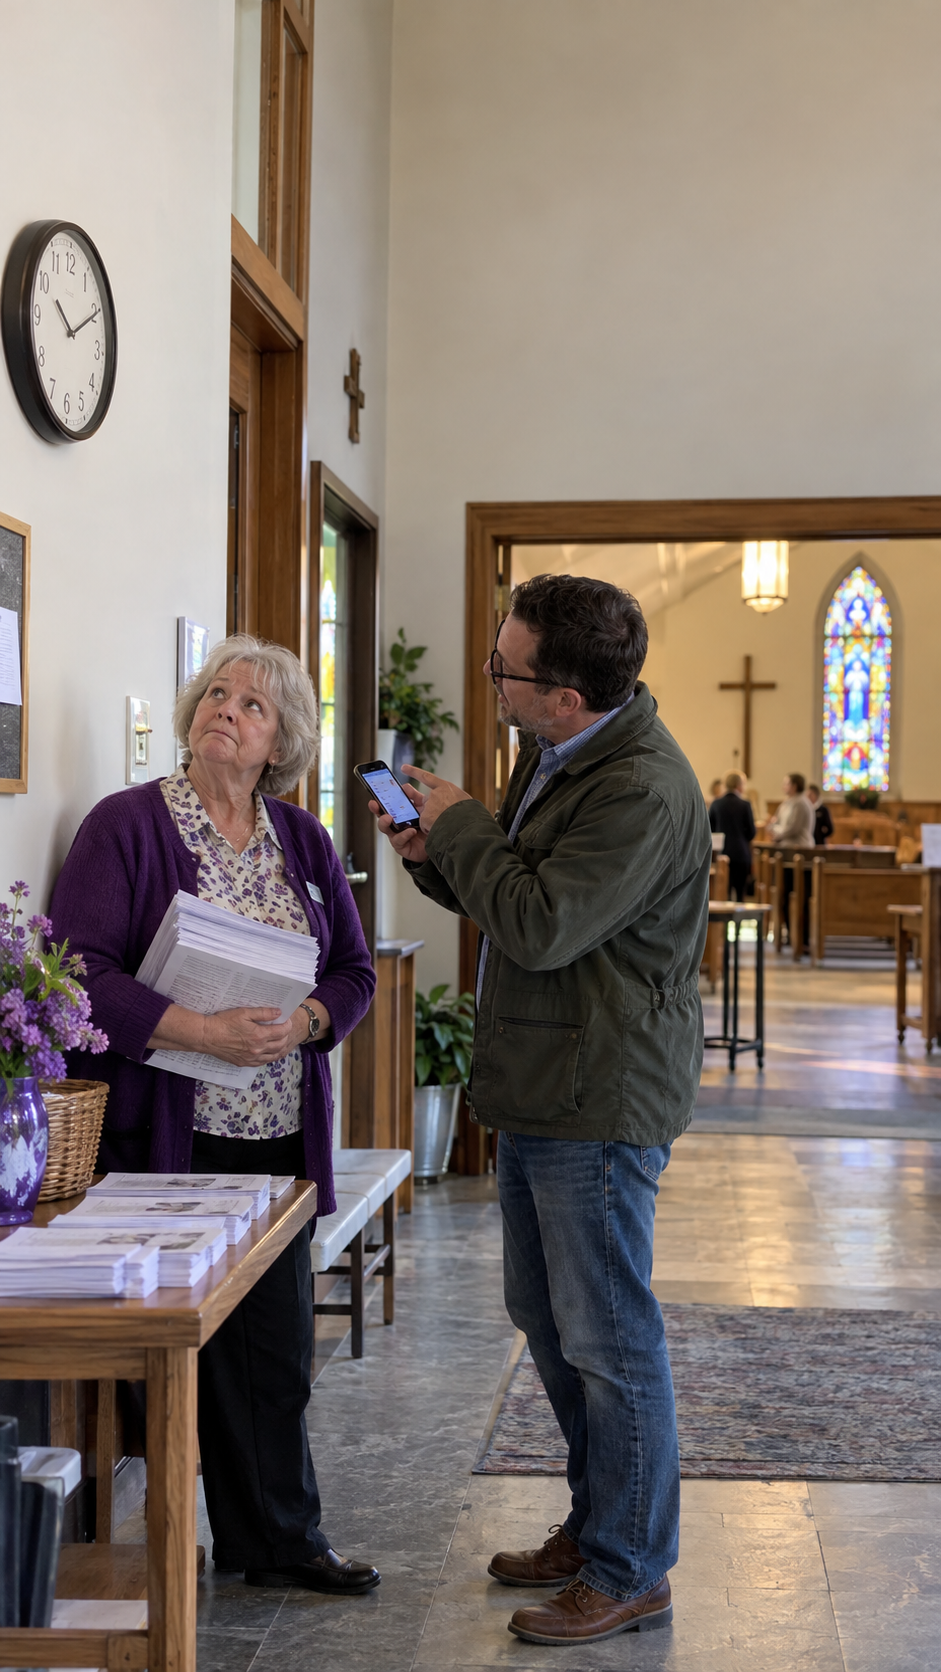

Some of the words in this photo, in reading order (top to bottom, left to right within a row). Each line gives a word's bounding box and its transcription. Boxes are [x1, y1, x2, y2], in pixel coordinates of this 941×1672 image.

[52, 251, 60, 274] 11
[66, 251, 76, 276] 12
[39, 270, 50, 294] 10
[83, 272, 87, 292] 1
[35, 303, 41, 326] 9
[91, 303, 98, 323] 2
[38, 345, 45, 367] 8
[94, 340, 101, 360] 3
[49, 378, 56, 399] 7
[89, 372, 95, 392] 4
[64, 392, 71, 414] 6
[78, 391, 84, 411] 5
